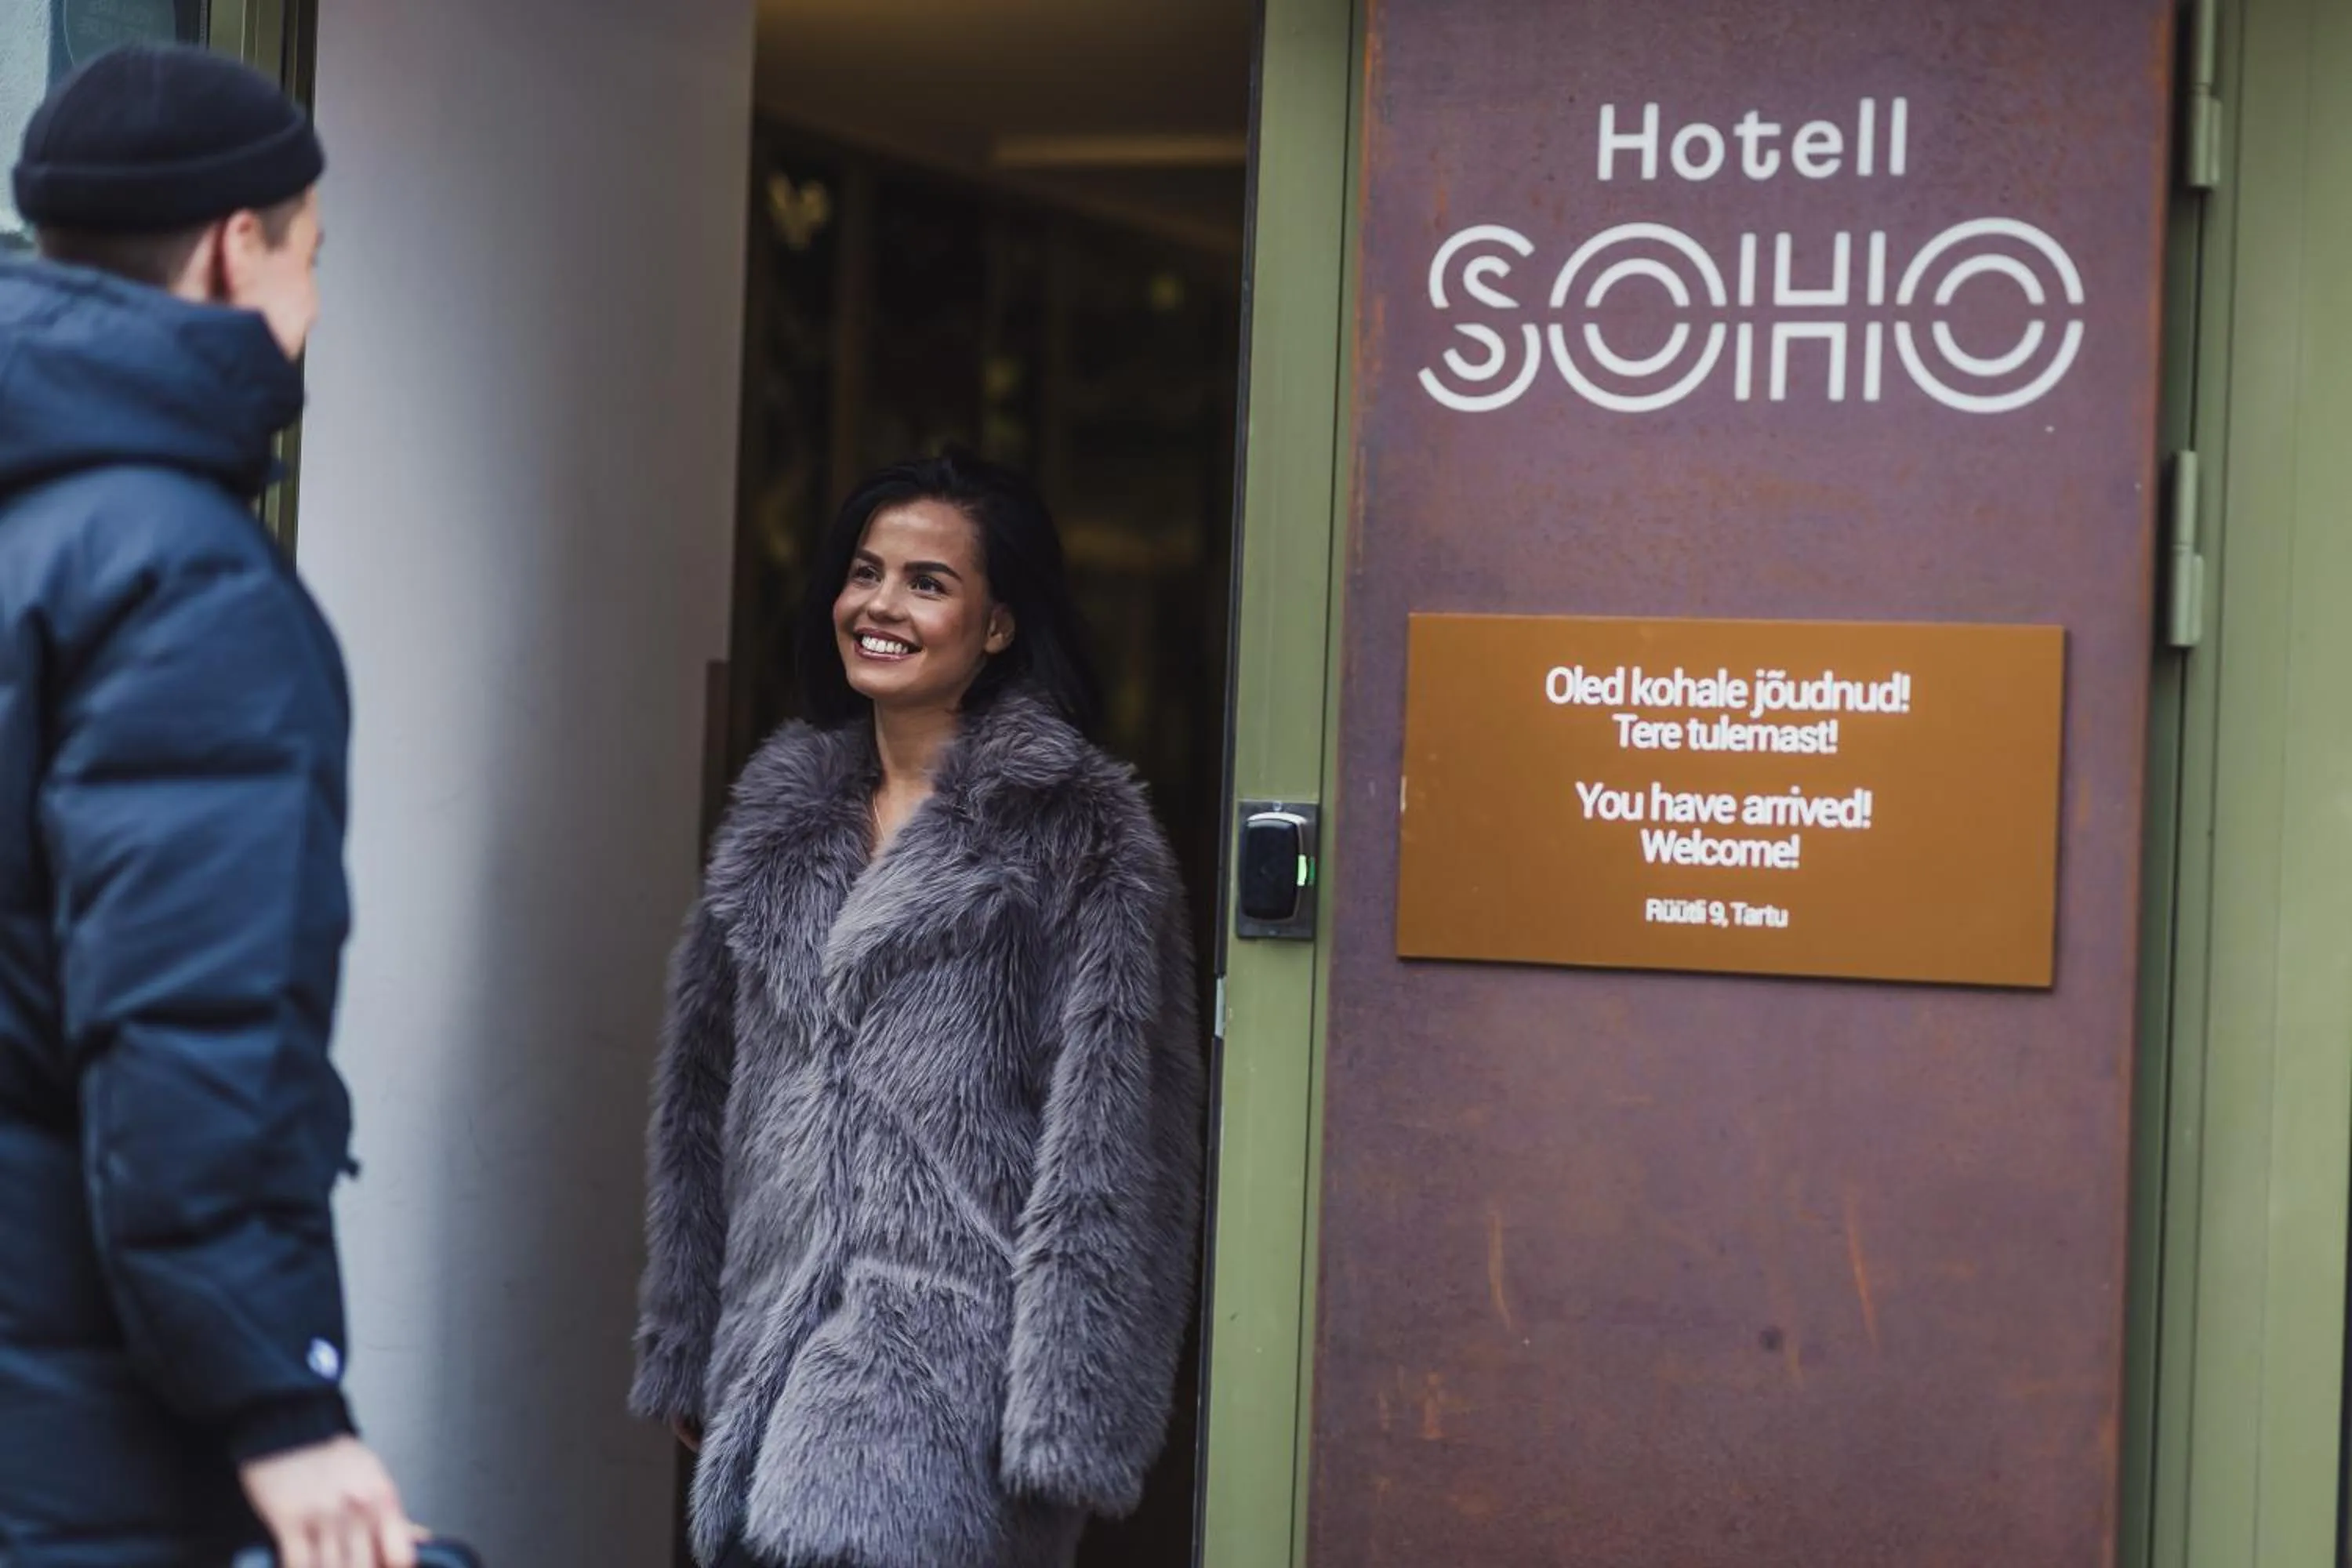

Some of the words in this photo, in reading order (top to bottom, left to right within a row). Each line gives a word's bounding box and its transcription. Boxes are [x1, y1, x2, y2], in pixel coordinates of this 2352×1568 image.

[1598, 97, 1907, 180] Hotell
[1418, 217, 2084, 413] SOHO
[1545, 666, 1625, 706] Oled
[1630, 666, 1748, 709] kohale
[1750, 669, 1911, 717] jõudnud!
[1612, 713, 1683, 750] Tere
[1686, 716, 1838, 753] tulemast!
[1575, 782, 1644, 821] You
[1650, 782, 1737, 825] have
[1742, 786, 1872, 829] arrived!
[1640, 829, 1801, 869] Welcome!
[1708, 901, 1729, 927] 9,
[1730, 902, 1789, 928] Tartu
